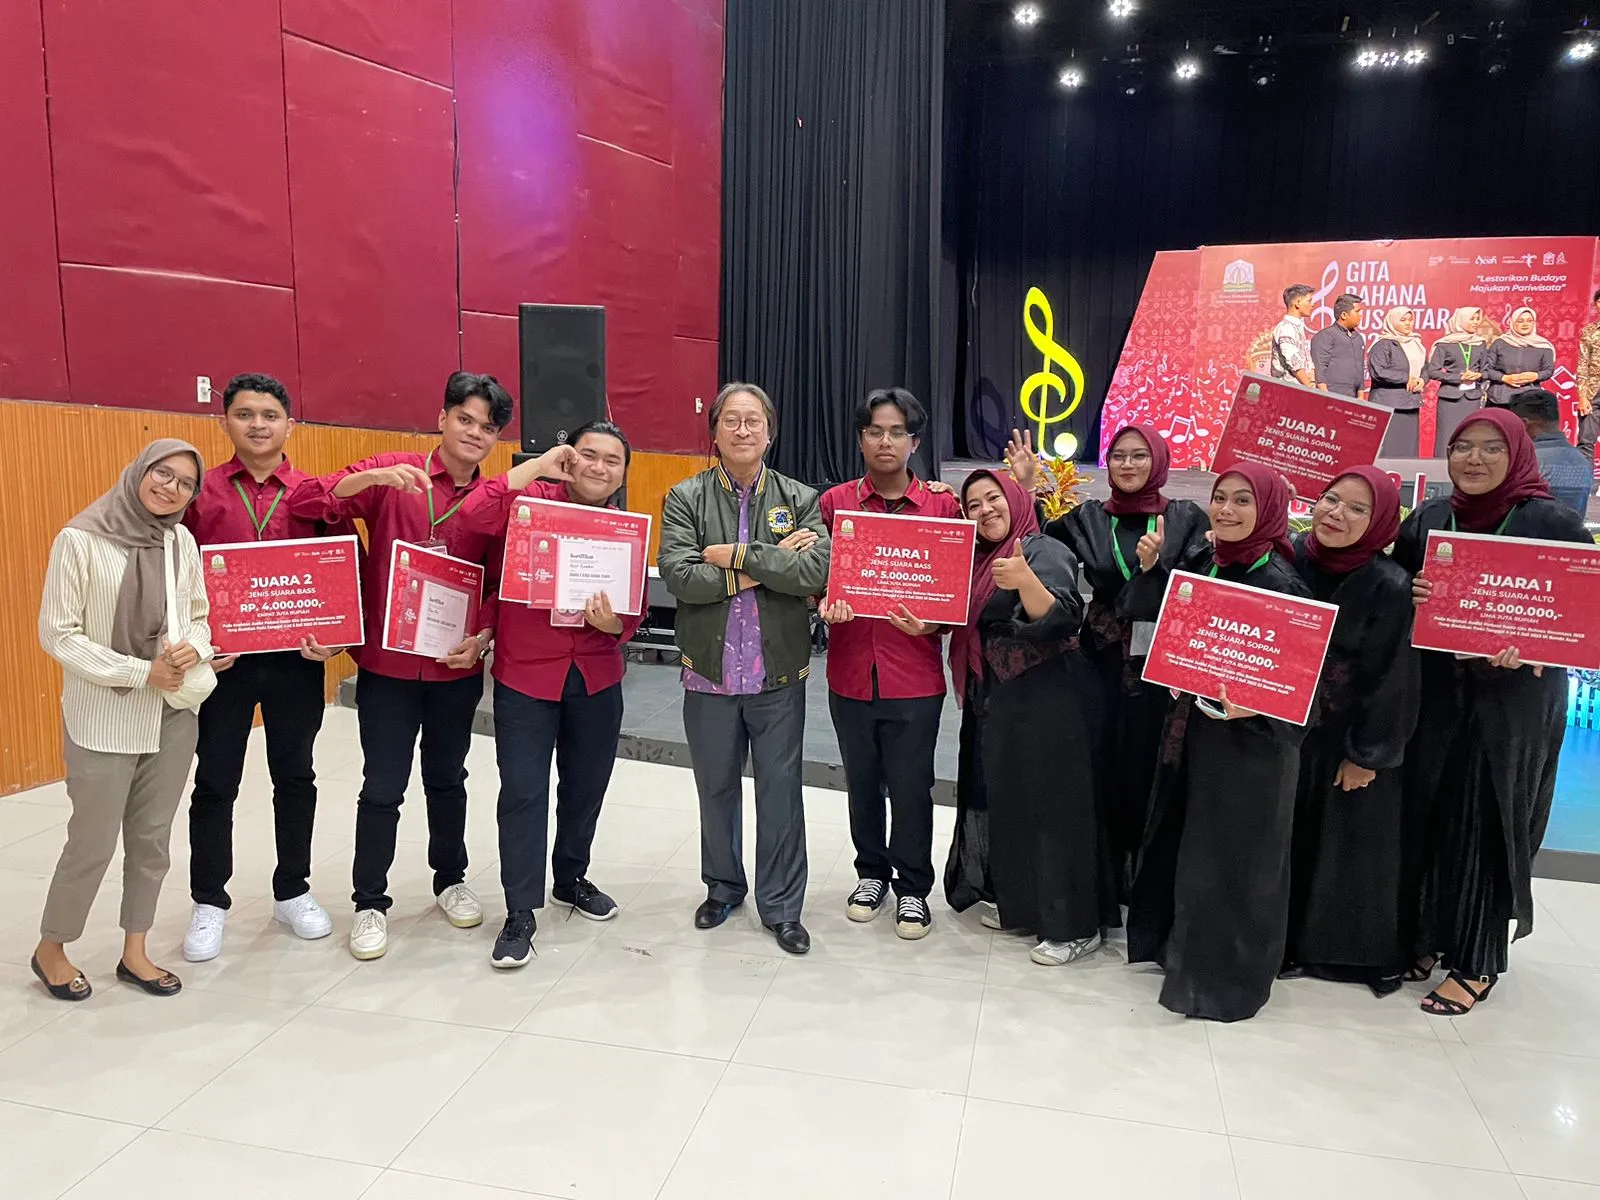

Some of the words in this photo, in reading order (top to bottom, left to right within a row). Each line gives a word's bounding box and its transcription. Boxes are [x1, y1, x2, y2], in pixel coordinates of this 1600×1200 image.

[1346, 260, 1390, 283] GITA
[1530, 274, 1567, 284] Budaya
[1470, 284, 1510, 294] Majukan
[1276, 416, 1326, 438] JUARA
[1330, 429, 1336, 440] 1
[1264, 426, 1284, 437] JENIS
[1285, 432, 1310, 444] SUARA
[1310, 438, 1342, 452] SOPRAN
[1257, 436, 1275, 448] RP.
[1277, 442, 1339, 466] 5.000.000,-
[874, 546, 920, 560] JUARA
[923, 550, 929, 560] 1
[250, 574, 301, 588] JUARA
[303, 573, 313, 585] 2
[860, 568, 878, 578] RP.
[880, 570, 938, 584] 5.000.000,-
[1478, 573, 1540, 591] JUARA
[1544, 580, 1552, 592] 1
[248, 590, 270, 598] JENIS
[1472, 588, 1498, 597] JENIS
[1498, 590, 1530, 600] SUARA
[1530, 594, 1555, 604] ALTO
[240, 604, 259, 612] RP.
[261, 598, 326, 611] 4.000.000,-
[1460, 598, 1482, 610] RP.
[1485, 602, 1563, 621] 5.000.000,-
[1208, 616, 1261, 639] JUARA
[1264, 630, 1276, 642] 2
[1196, 628, 1218, 639] JENIS
[1219, 634, 1246, 646] SUARA
[1246, 640, 1280, 655] SOPRAN
[1188, 638, 1208, 652] RP.
[1210, 645, 1280, 671] 4.000.000,-
